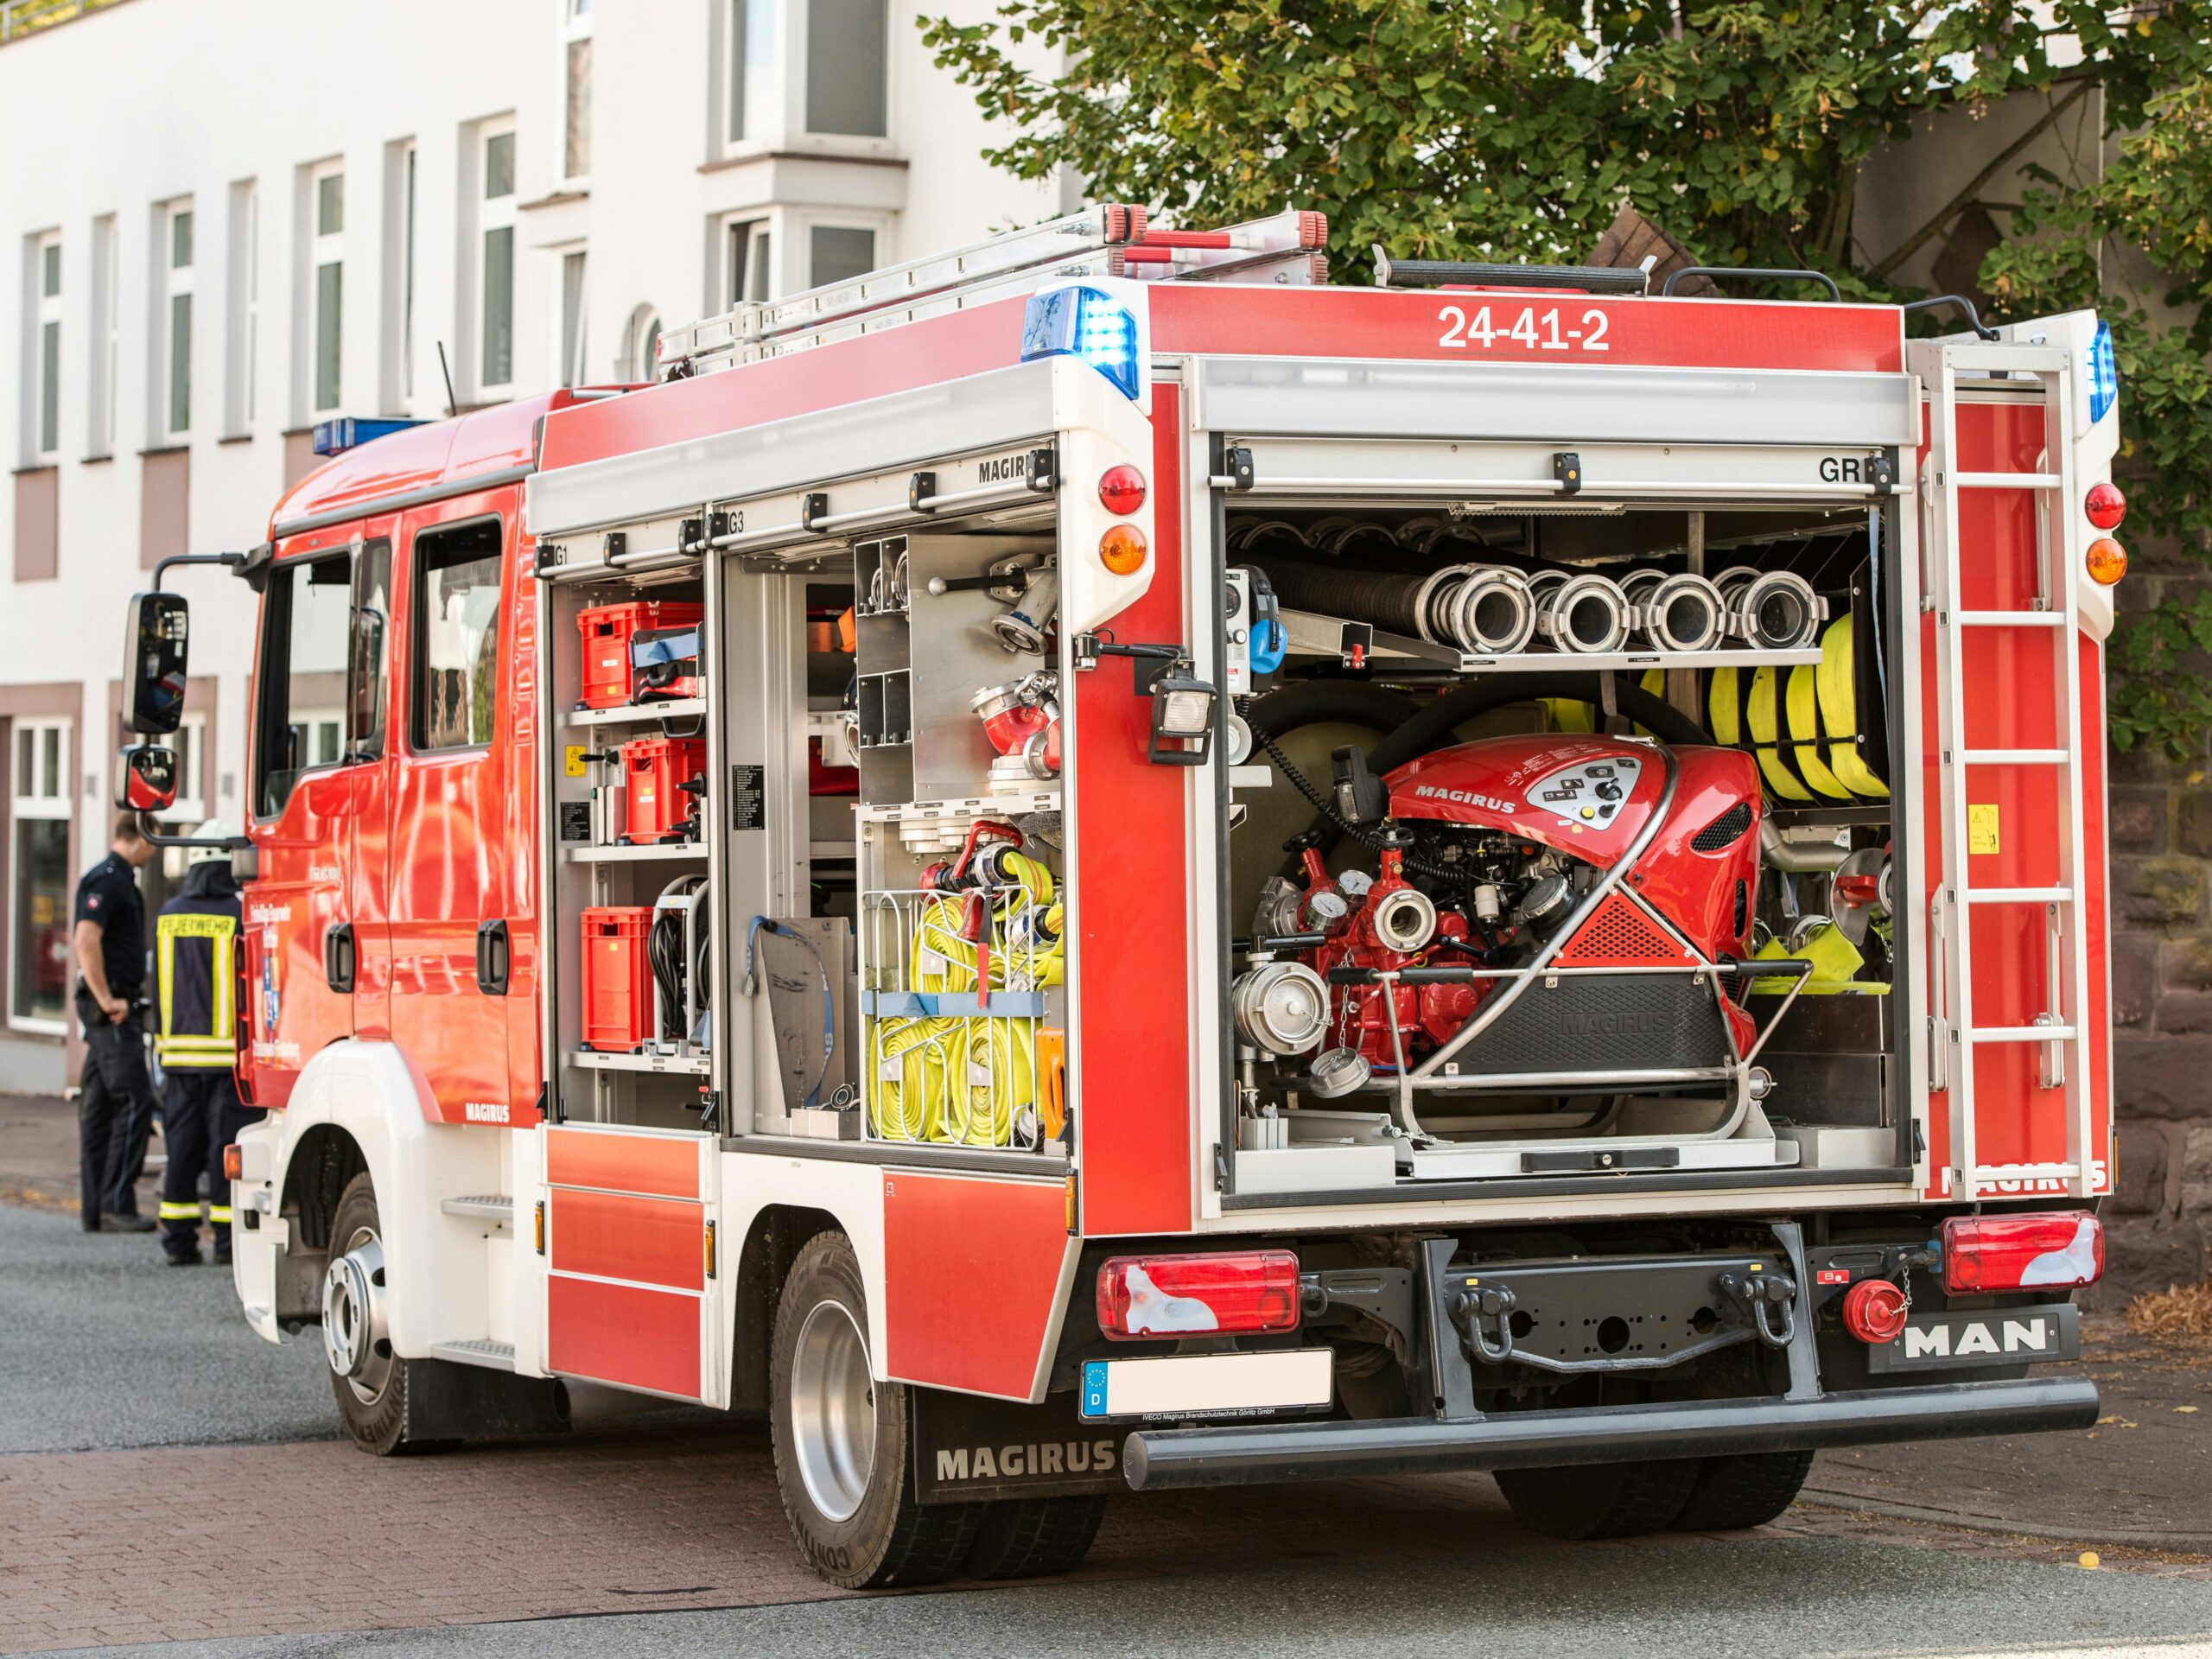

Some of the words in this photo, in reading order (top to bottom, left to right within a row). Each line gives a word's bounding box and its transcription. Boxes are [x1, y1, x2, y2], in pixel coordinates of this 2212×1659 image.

[1439, 306, 1609, 351] 24-41-2
[979, 454, 1029, 484] MAGIR
[1820, 458, 1860, 483] GR
[728, 511, 744, 534] G3
[555, 545, 568, 565] G1
[1415, 785, 1516, 815] MAGIRUS
[1561, 1010, 1673, 1035] MAGIRUS
[465, 1103, 510, 1122] MAGIRUS
[1904, 1319, 2047, 1357] MAN
[1091, 1393, 1101, 1406] D
[1162, 1412, 1185, 1421] Magirus
[937, 1440, 1116, 1480] MAGIRUS
